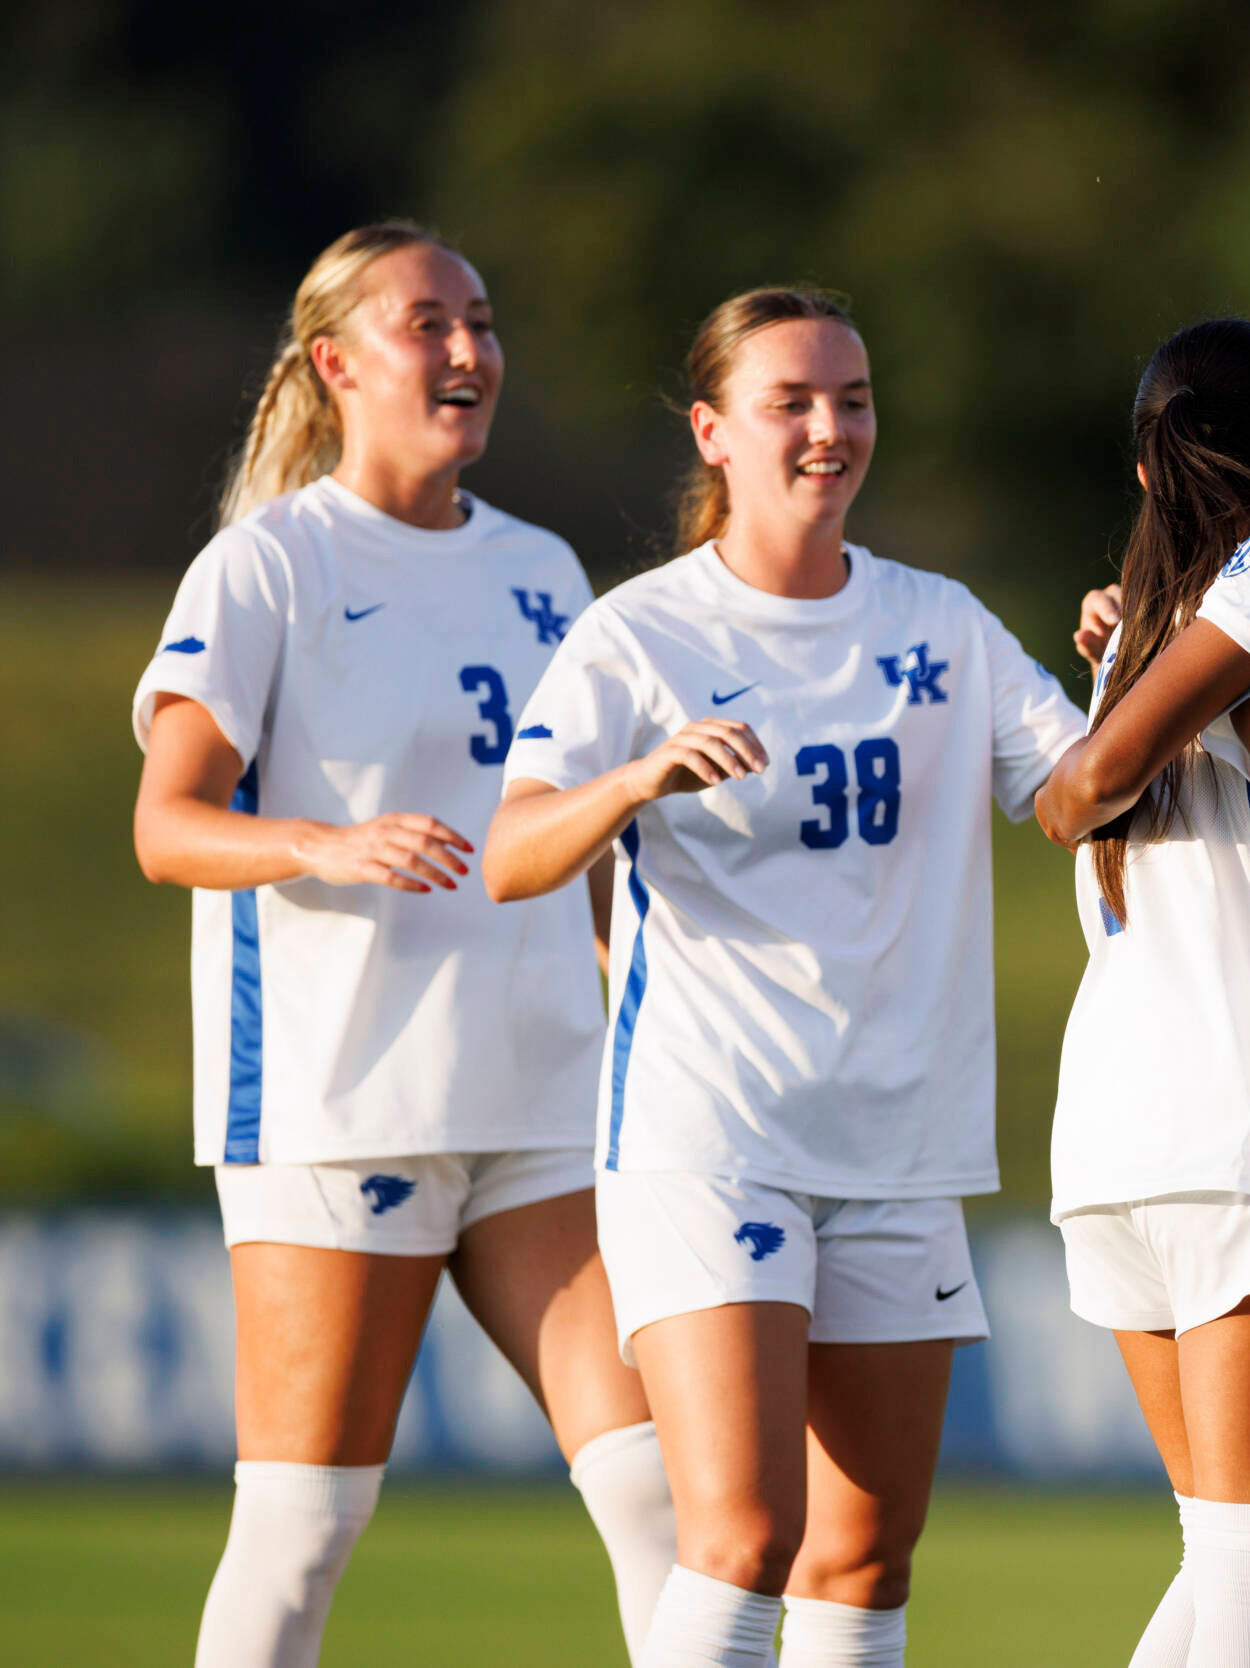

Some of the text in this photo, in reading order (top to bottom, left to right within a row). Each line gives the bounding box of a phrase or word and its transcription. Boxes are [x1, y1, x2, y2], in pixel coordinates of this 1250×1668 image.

[510, 588, 569, 645] UK
[876, 641, 949, 705] UK
[458, 665, 515, 766] 3
[795, 737, 901, 850] 38
